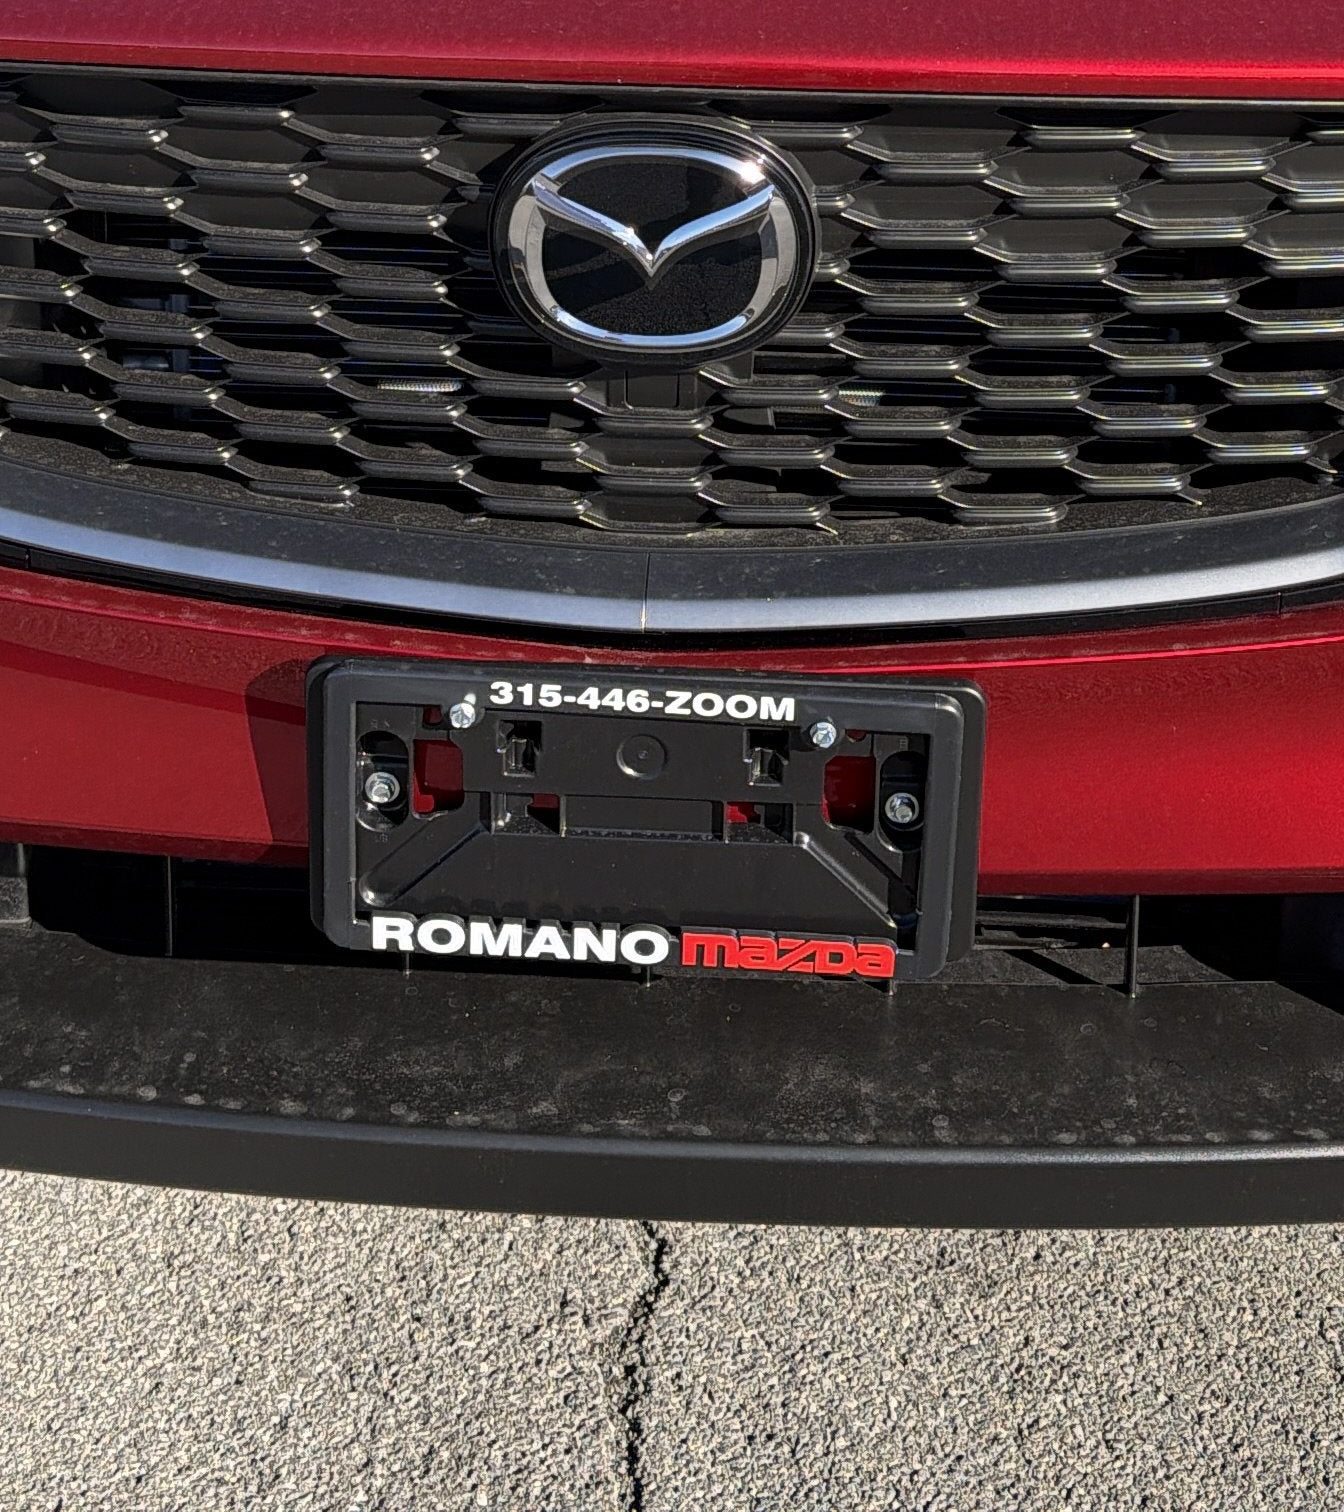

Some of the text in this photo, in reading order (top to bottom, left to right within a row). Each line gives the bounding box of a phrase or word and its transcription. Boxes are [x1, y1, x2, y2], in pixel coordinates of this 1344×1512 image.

[489, 681, 796, 722] 315-446-ZOOM
[370, 916, 896, 979] ROMANO mazda
